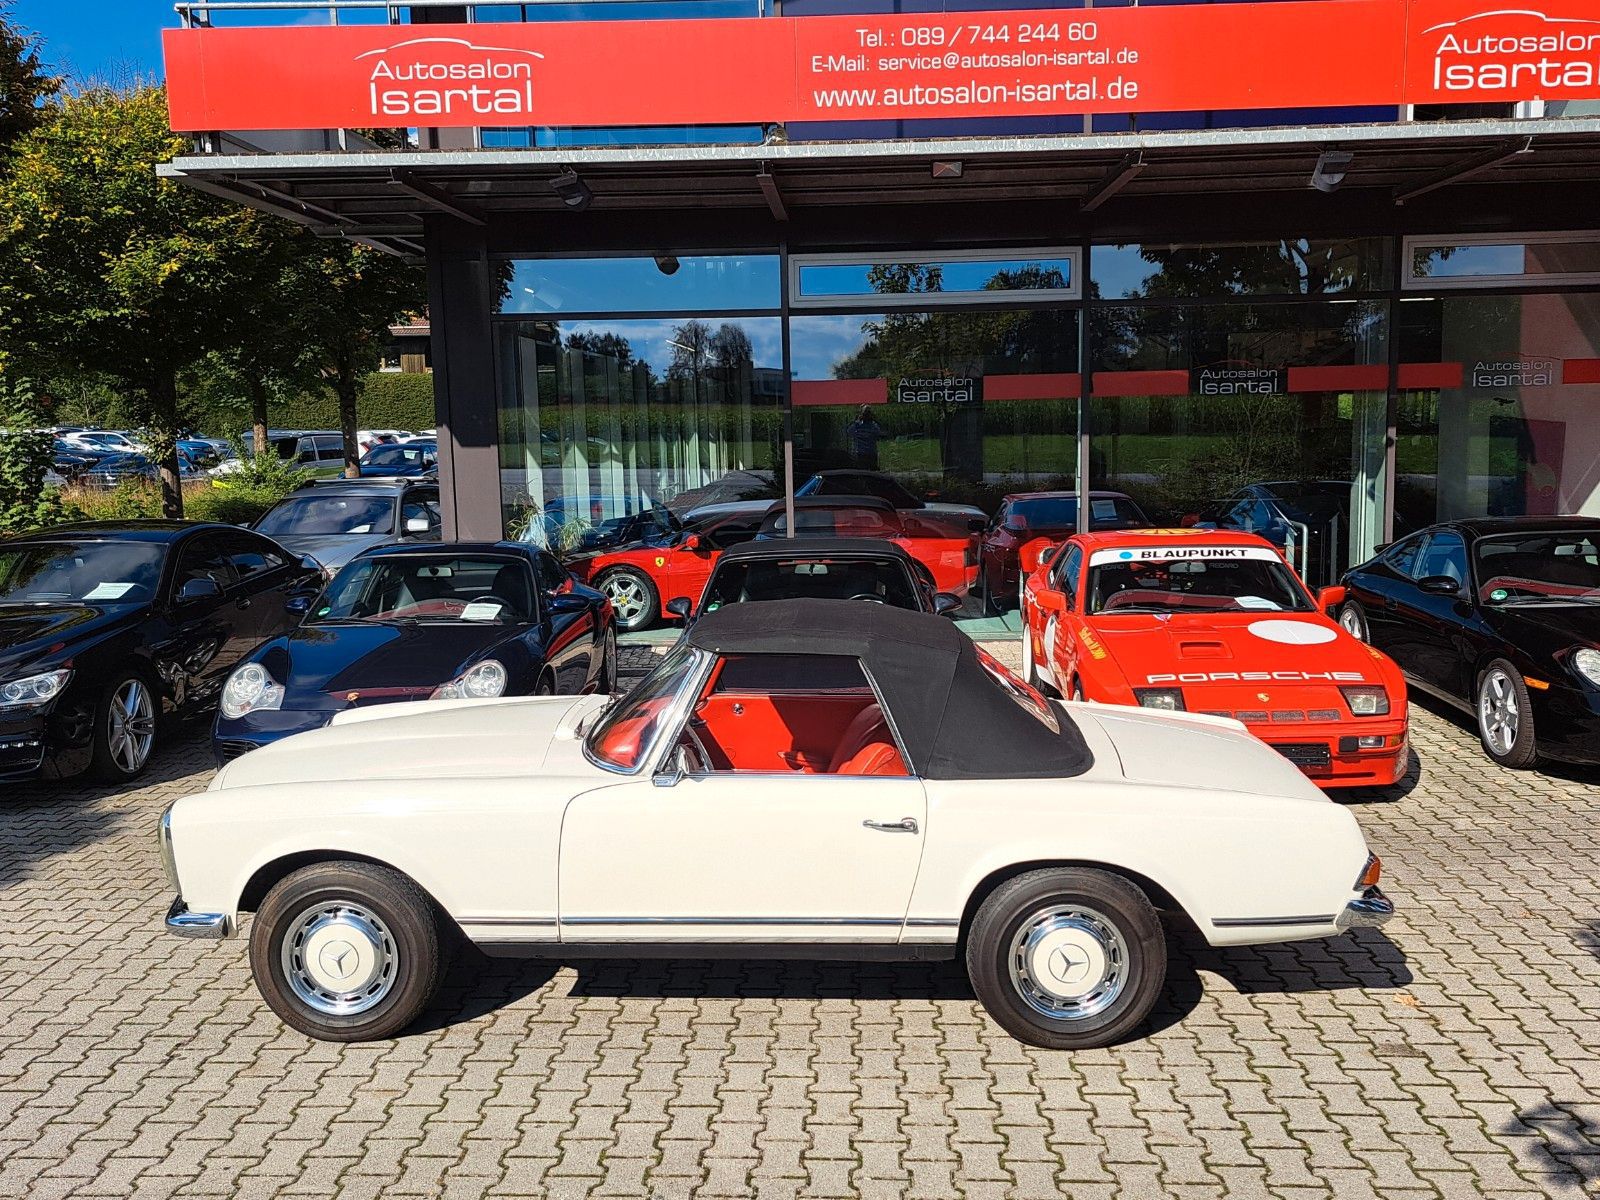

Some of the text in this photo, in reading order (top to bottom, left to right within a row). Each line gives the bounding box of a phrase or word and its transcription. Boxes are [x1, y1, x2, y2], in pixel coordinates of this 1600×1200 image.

[856, 28, 895, 48] Tel.:
[1017, 24, 1061, 43] 244
[1068, 22, 1097, 41] 60
[811, 47, 1139, 73] E-Mail: service@autosalon-isartal.de
[370, 58, 531, 81] Autosalon
[369, 80, 533, 115] Isartal
[813, 76, 1139, 108] www.autosalon-isartal.de
[1200, 368, 1278, 379] Autosalon
[1473, 360, 1552, 371] Autosalon
[898, 377, 973, 387] Autosalon
[1199, 378, 1278, 395] Isartal
[1472, 369, 1552, 387] Isartal
[897, 386, 973, 403] Isartal
[1141, 549, 1248, 559] BLAUPUNKT
[1146, 671, 1365, 684] PORSCHE
